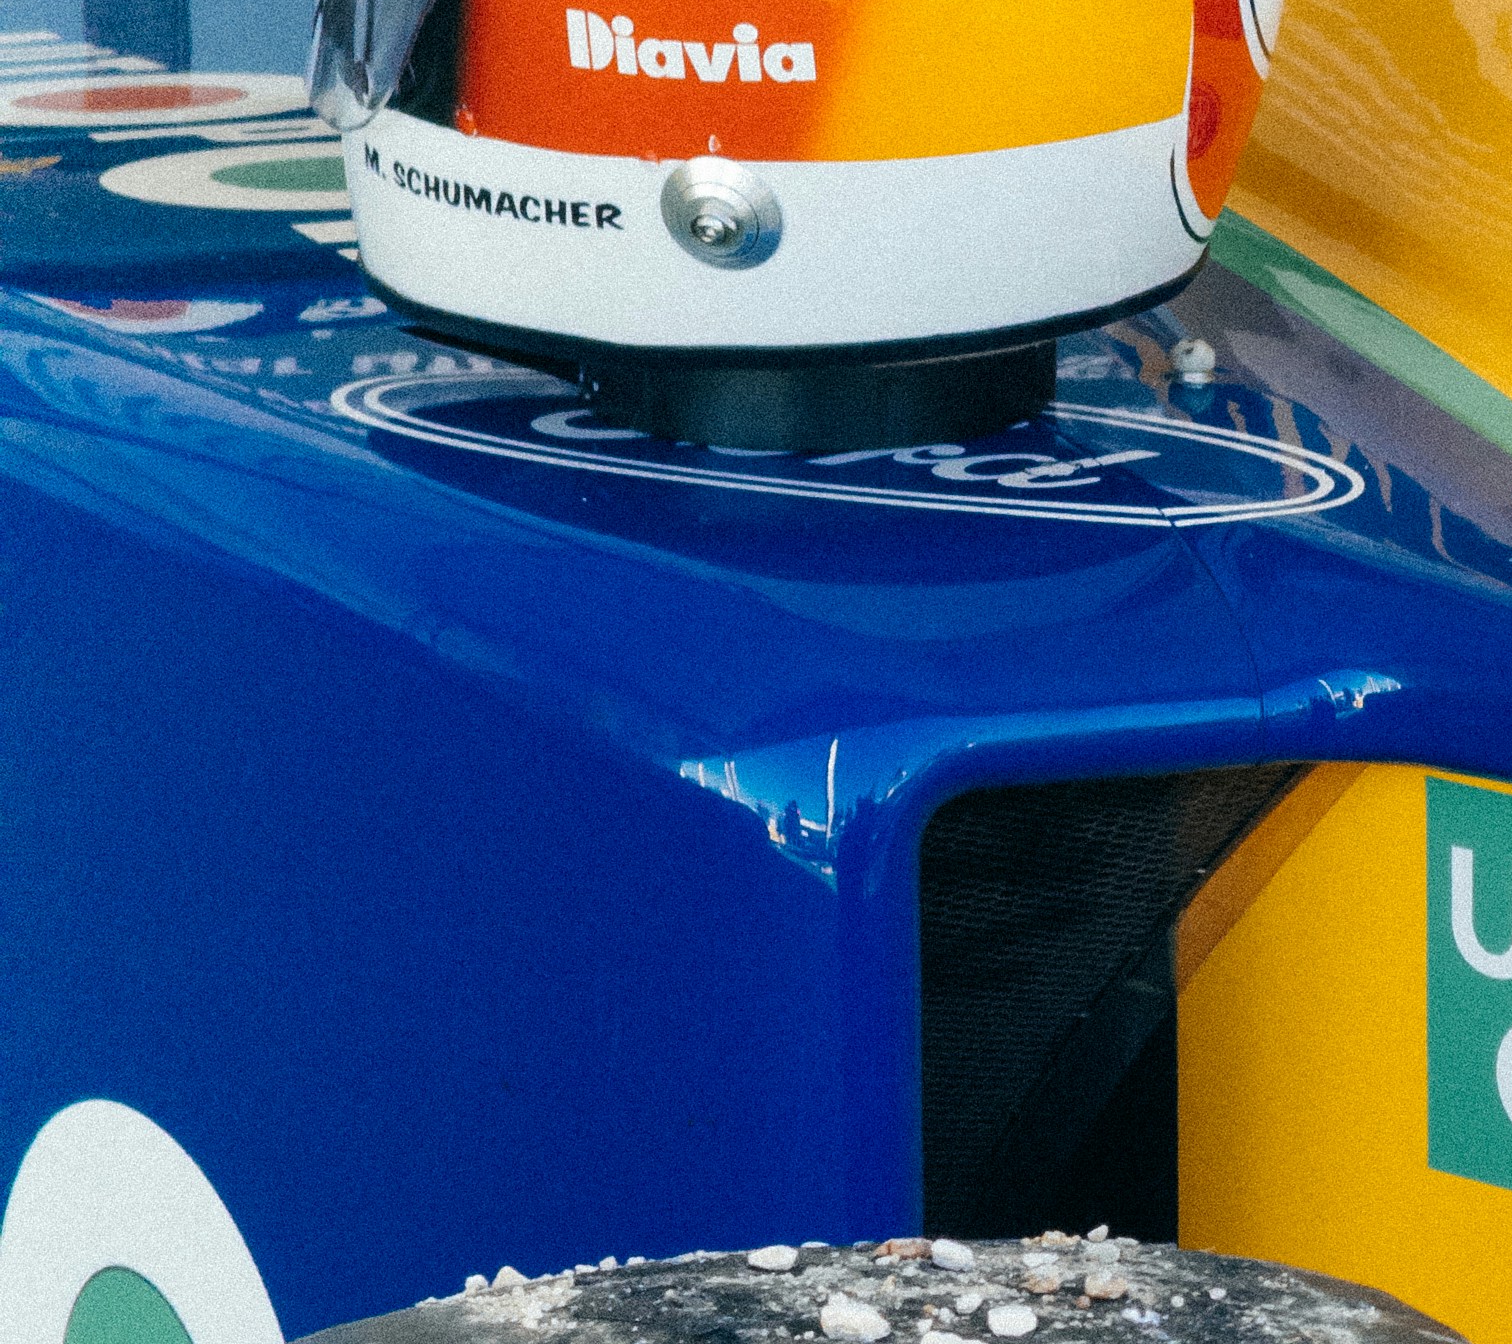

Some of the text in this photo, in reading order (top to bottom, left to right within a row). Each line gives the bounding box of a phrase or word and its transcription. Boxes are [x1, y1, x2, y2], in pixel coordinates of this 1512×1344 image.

[565, 8, 817, 83] Diavia
[364, 142, 625, 231] M. SCHUMACHER
